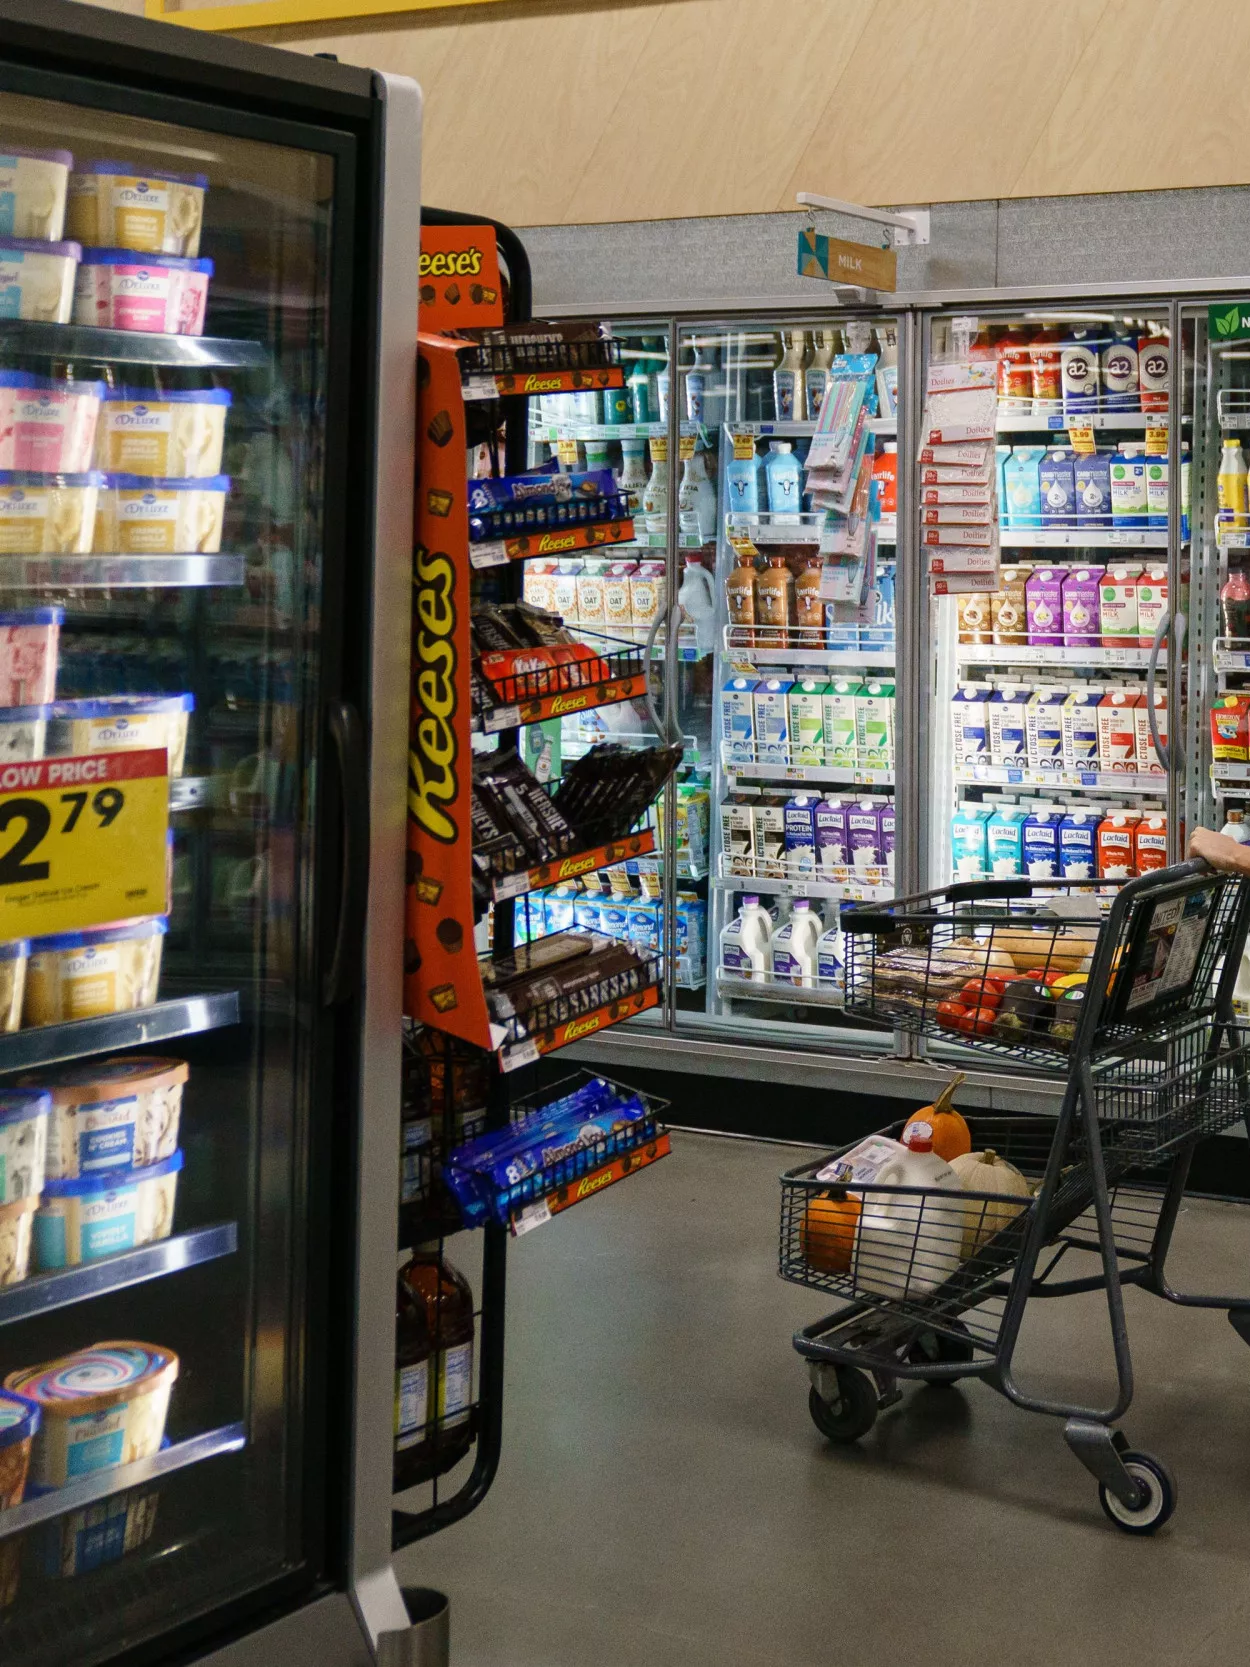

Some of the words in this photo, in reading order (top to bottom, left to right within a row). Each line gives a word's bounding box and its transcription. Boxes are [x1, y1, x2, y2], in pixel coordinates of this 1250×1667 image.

[420, 247, 483, 277] eese's
[838, 254, 863, 271] MILK
[1068, 360, 1088, 376] a2
[1110, 359, 1129, 376] a2
[1147, 360, 1166, 375] a2
[524, 374, 562, 392] Reese's
[115, 414, 160, 426] DELUXE
[966, 425, 990, 435] Doilies
[1071, 429, 1090, 439] 3.99
[1148, 429, 1167, 439] 3.99
[957, 450, 982, 459] Doilies
[961, 488, 987, 498] Doilies
[124, 502, 169, 514] DELUXE
[961, 509, 987, 518] Doilies
[962, 531, 987, 540] Doilies
[538, 534, 576, 552] Reese's
[967, 557, 991, 566] Doilies
[970, 577, 995, 587] Doilies
[531, 595, 545, 603] OAT
[557, 596, 571, 604] OAT
[584, 597, 597, 605] OAT
[609, 597, 623, 605] OAT
[636, 598, 650, 606] OAT
[407, 550, 455, 840] Reese's
[551, 695, 587, 714] Reese's
[1215, 713, 1241, 721] HORIZON
[1029, 715, 1037, 733] FREE
[1064, 716, 1072, 733] FREE
[1101, 717, 1109, 734] FREE
[1138, 719, 1147, 736] FREE
[0, 766, 42, 789] OW
[48, 758, 107, 784] PRICE
[787, 811, 810, 820] Lactaid
[818, 815, 842, 825] Lactaid
[722, 815, 731, 832] FREE
[755, 817, 763, 833] FREE
[850, 817, 875, 827] Lactaid
[785, 824, 813, 832] PROTEIN
[991, 826, 1017, 837] Lactaid
[1027, 828, 1053, 839] Lactaid
[0, 797, 51, 886] 2
[60, 787, 125, 834] 79
[1063, 830, 1089, 840] Lactaid
[1102, 833, 1128, 843] Lactaid
[1139, 835, 1165, 845] Lactaid
[559, 856, 596, 877] Reese's
[564, 1016, 600, 1041] Reese's
[577, 1169, 613, 1197] Reese's
